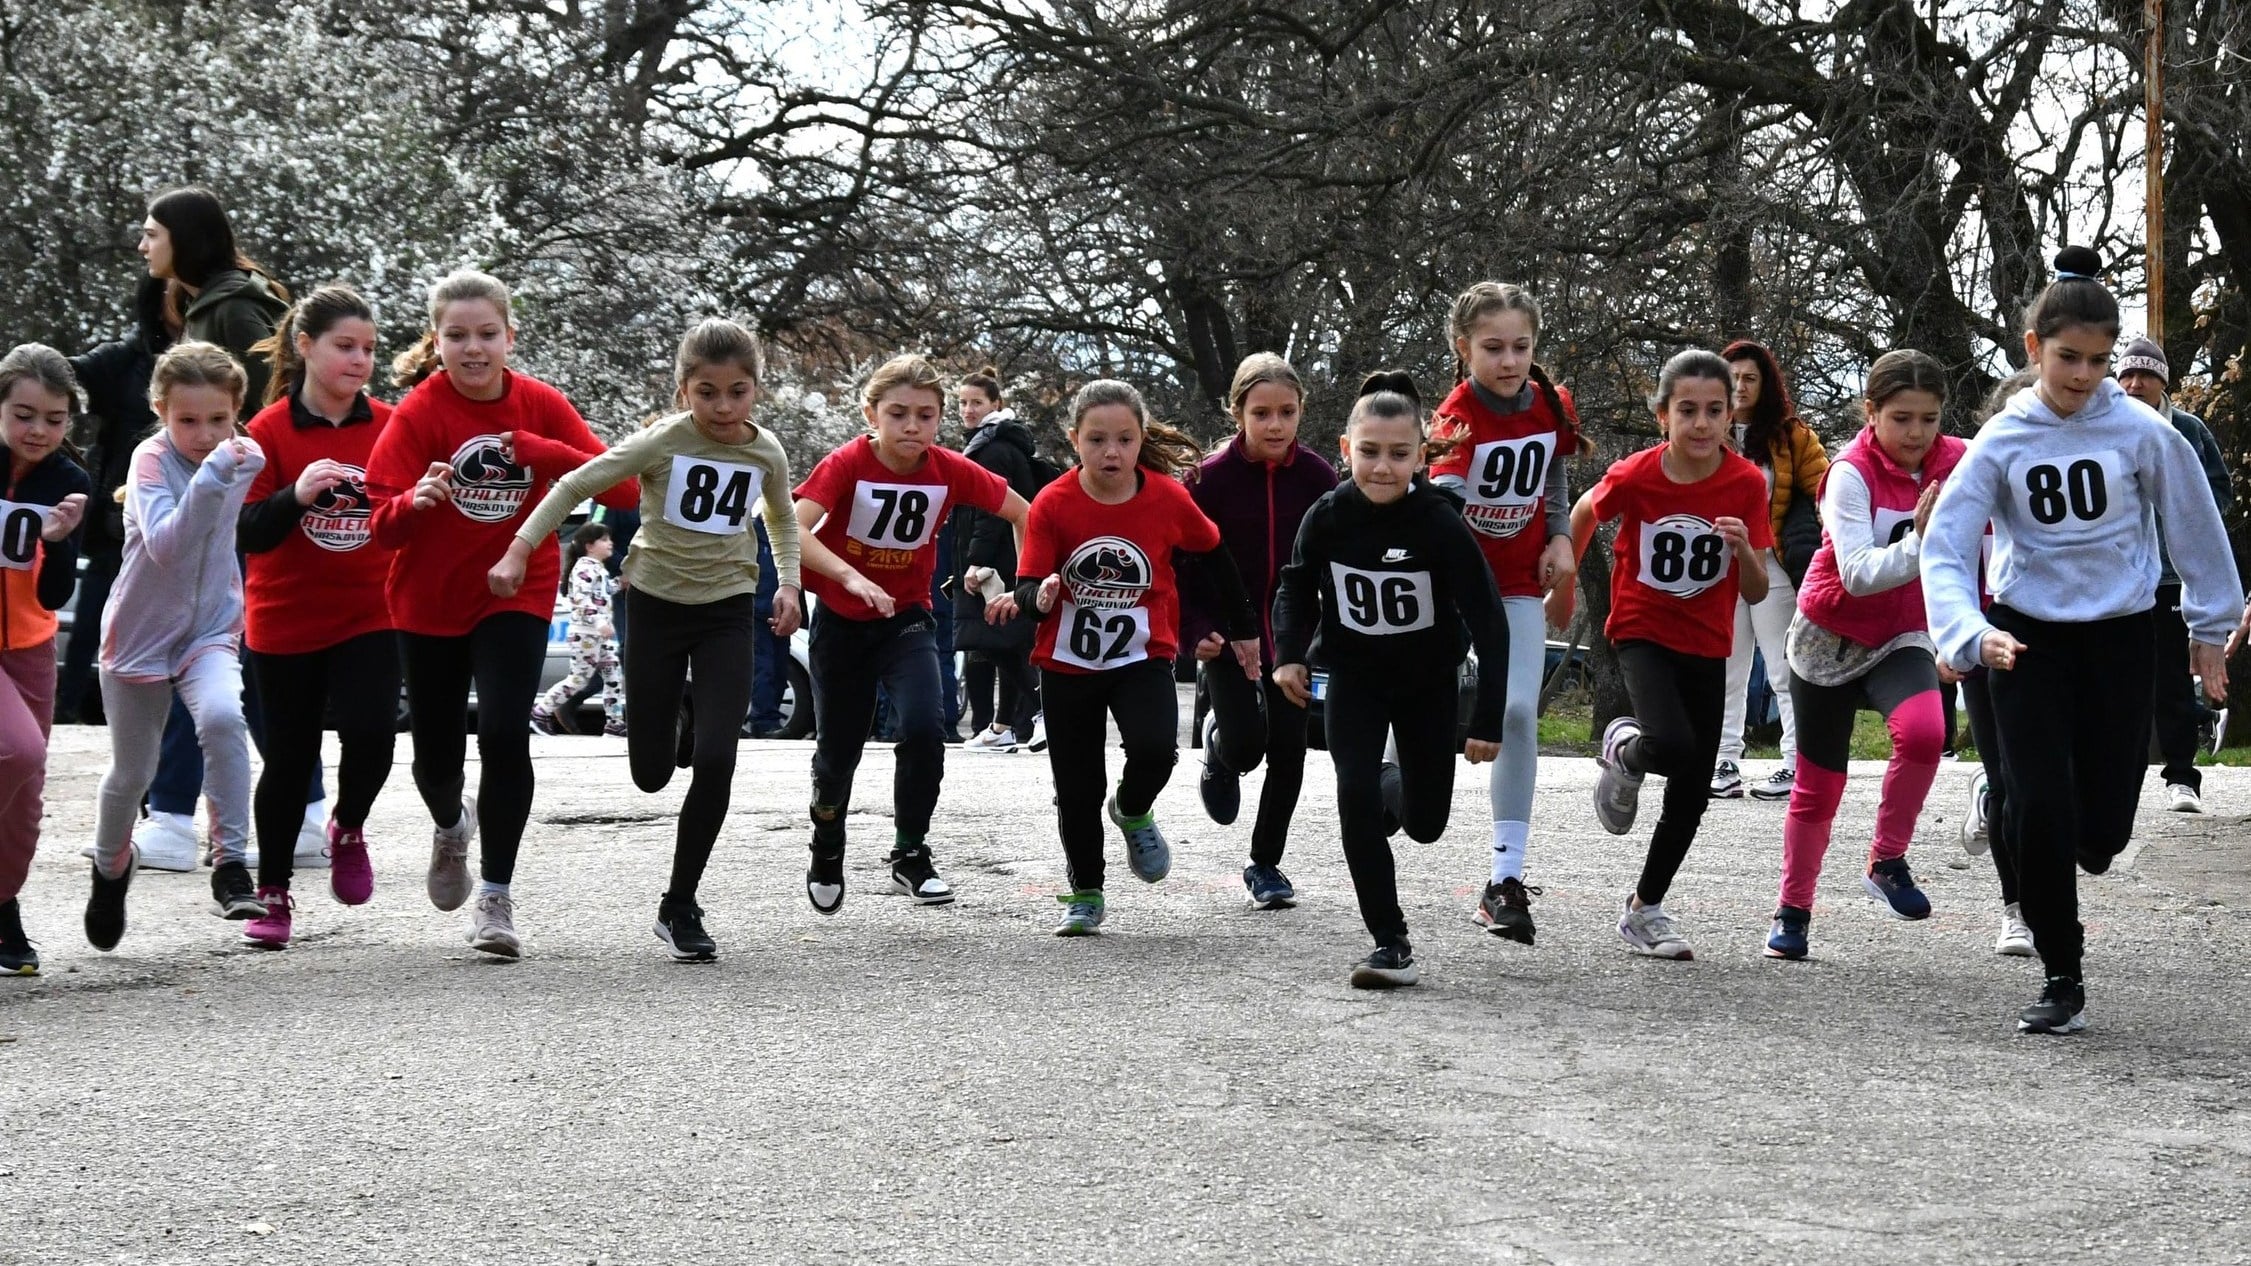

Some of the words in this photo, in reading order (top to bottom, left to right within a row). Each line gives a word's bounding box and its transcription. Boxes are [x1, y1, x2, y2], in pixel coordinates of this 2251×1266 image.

[680, 464, 752, 526] 84
[1478, 441, 1545, 498] 90
[2026, 459, 2107, 525] 80
[462, 501, 516, 513] HASKOVO
[867, 489, 929, 543] 78
[0, 506, 42, 563] 0
[1386, 548, 1408, 559] NIKE
[1651, 531, 1723, 583] 88
[1344, 573, 1419, 627] 96
[1070, 608, 1136, 663] 62
